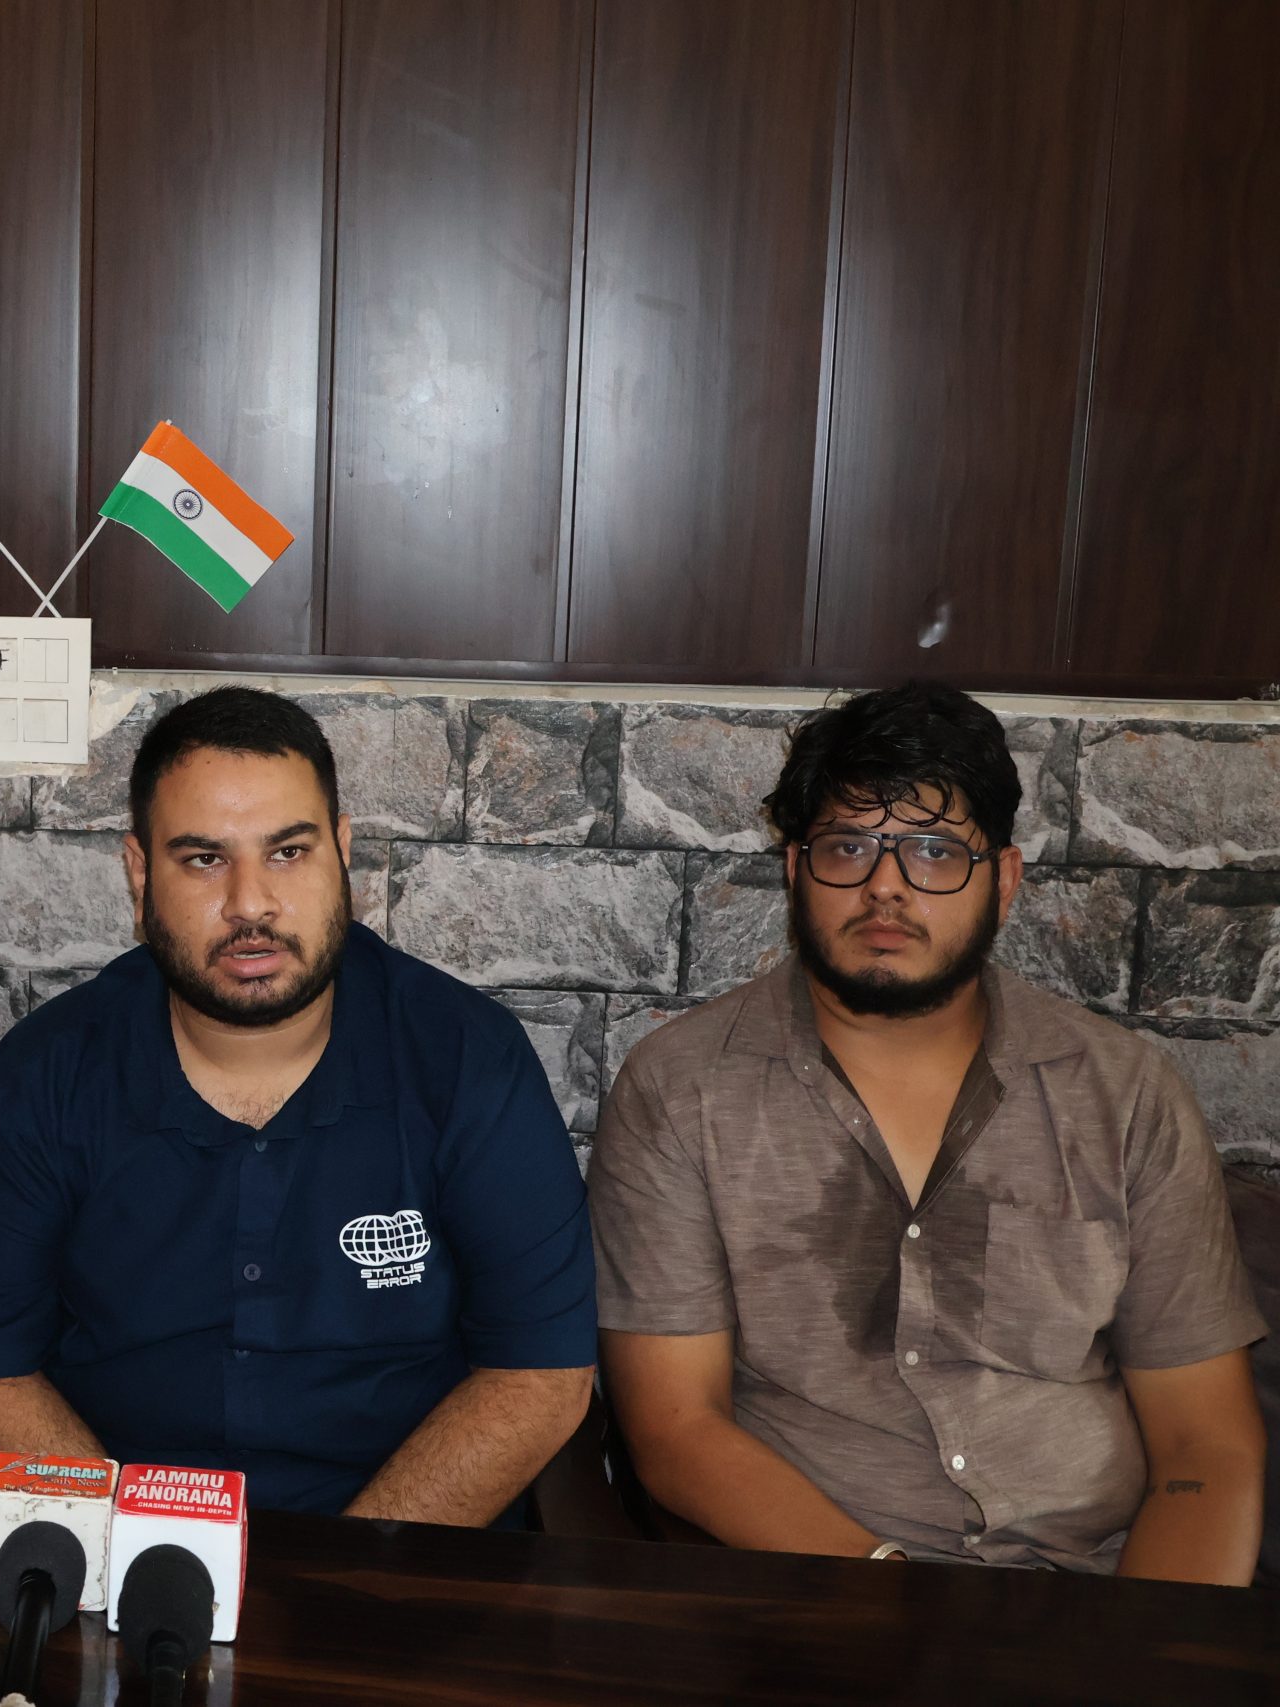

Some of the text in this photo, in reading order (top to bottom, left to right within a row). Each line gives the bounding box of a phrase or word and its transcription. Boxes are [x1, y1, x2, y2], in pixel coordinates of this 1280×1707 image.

[360, 1261, 425, 1278] STATUS
[366, 1273, 422, 1289] ERROR
[139, 1469, 225, 1489] JAMMU
[124, 1484, 233, 1509] PANORAMA
[173, 1504, 195, 1512] NEWS
[197, 1507, 232, 1516] IN-DEPTH
